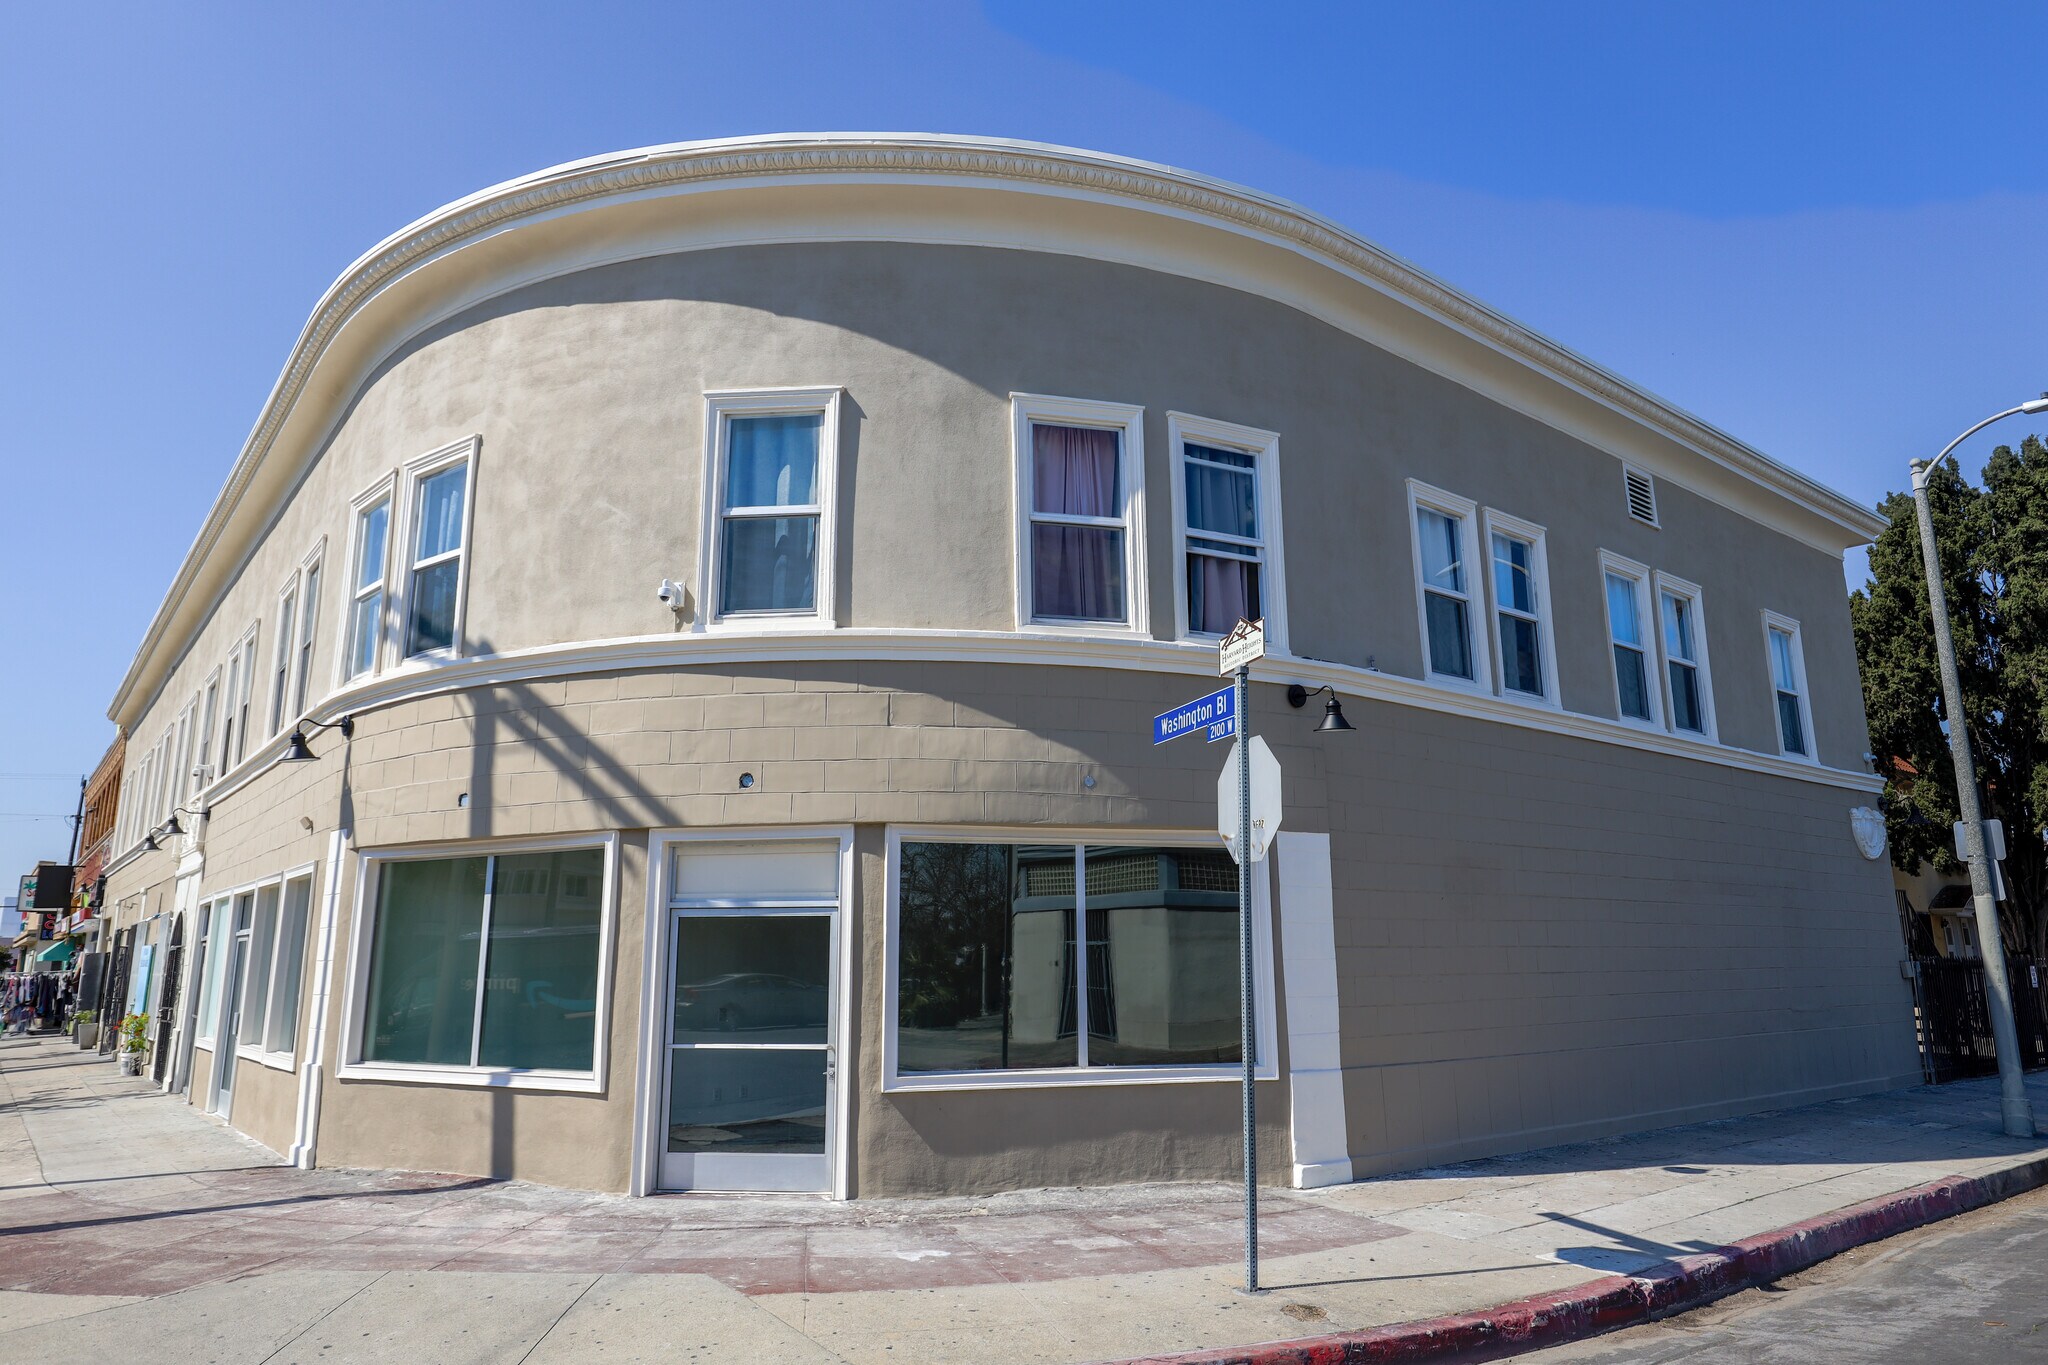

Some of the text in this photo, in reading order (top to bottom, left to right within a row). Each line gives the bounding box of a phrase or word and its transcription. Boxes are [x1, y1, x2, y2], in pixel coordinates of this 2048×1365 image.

[1161, 694, 1227, 736] Washington Bl
[1210, 719, 1233, 738] 2100 W
